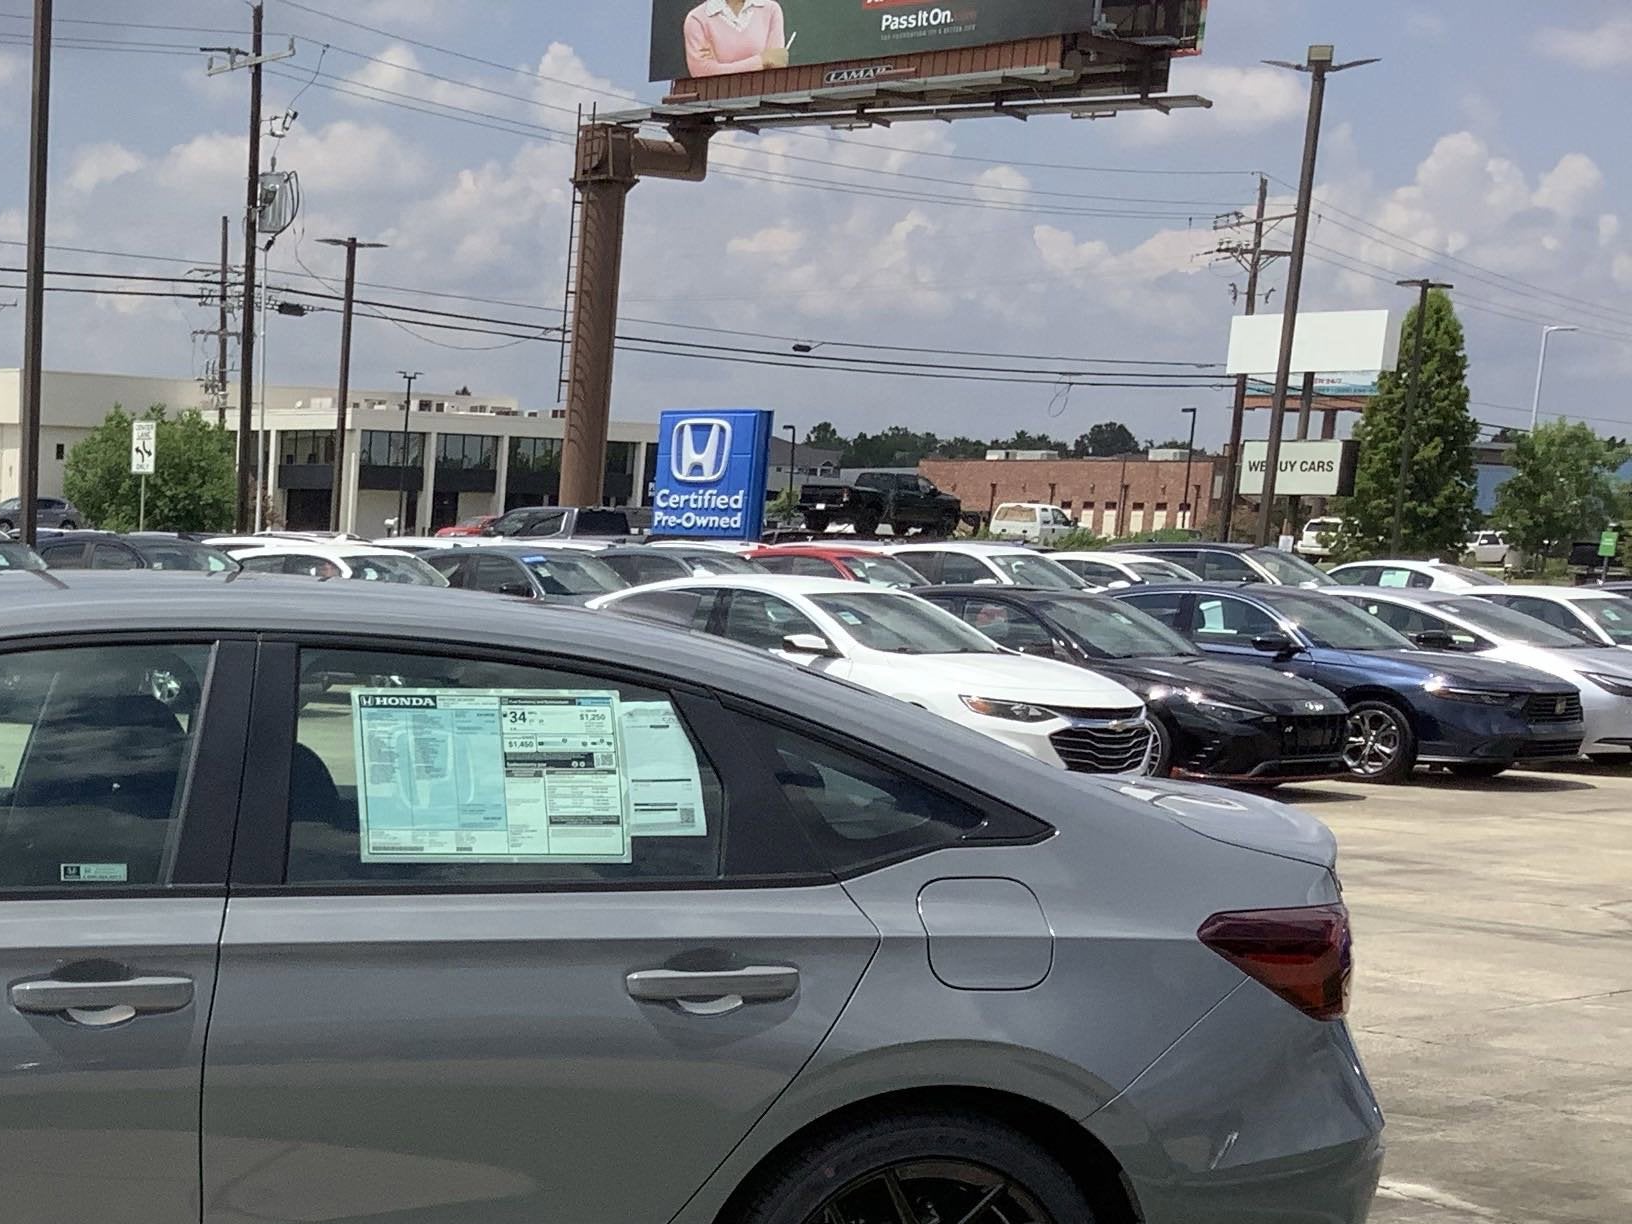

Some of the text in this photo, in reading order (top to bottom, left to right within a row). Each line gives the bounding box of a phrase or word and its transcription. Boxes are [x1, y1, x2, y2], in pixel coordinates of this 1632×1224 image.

[1278, 460, 1297, 472] UY
[1299, 460, 1334, 472] CARS
[656, 489, 744, 508] Certified
[654, 511, 741, 529] Pre-Owned
[375, 696, 435, 706] HONDA
[509, 711, 527, 723] 34
